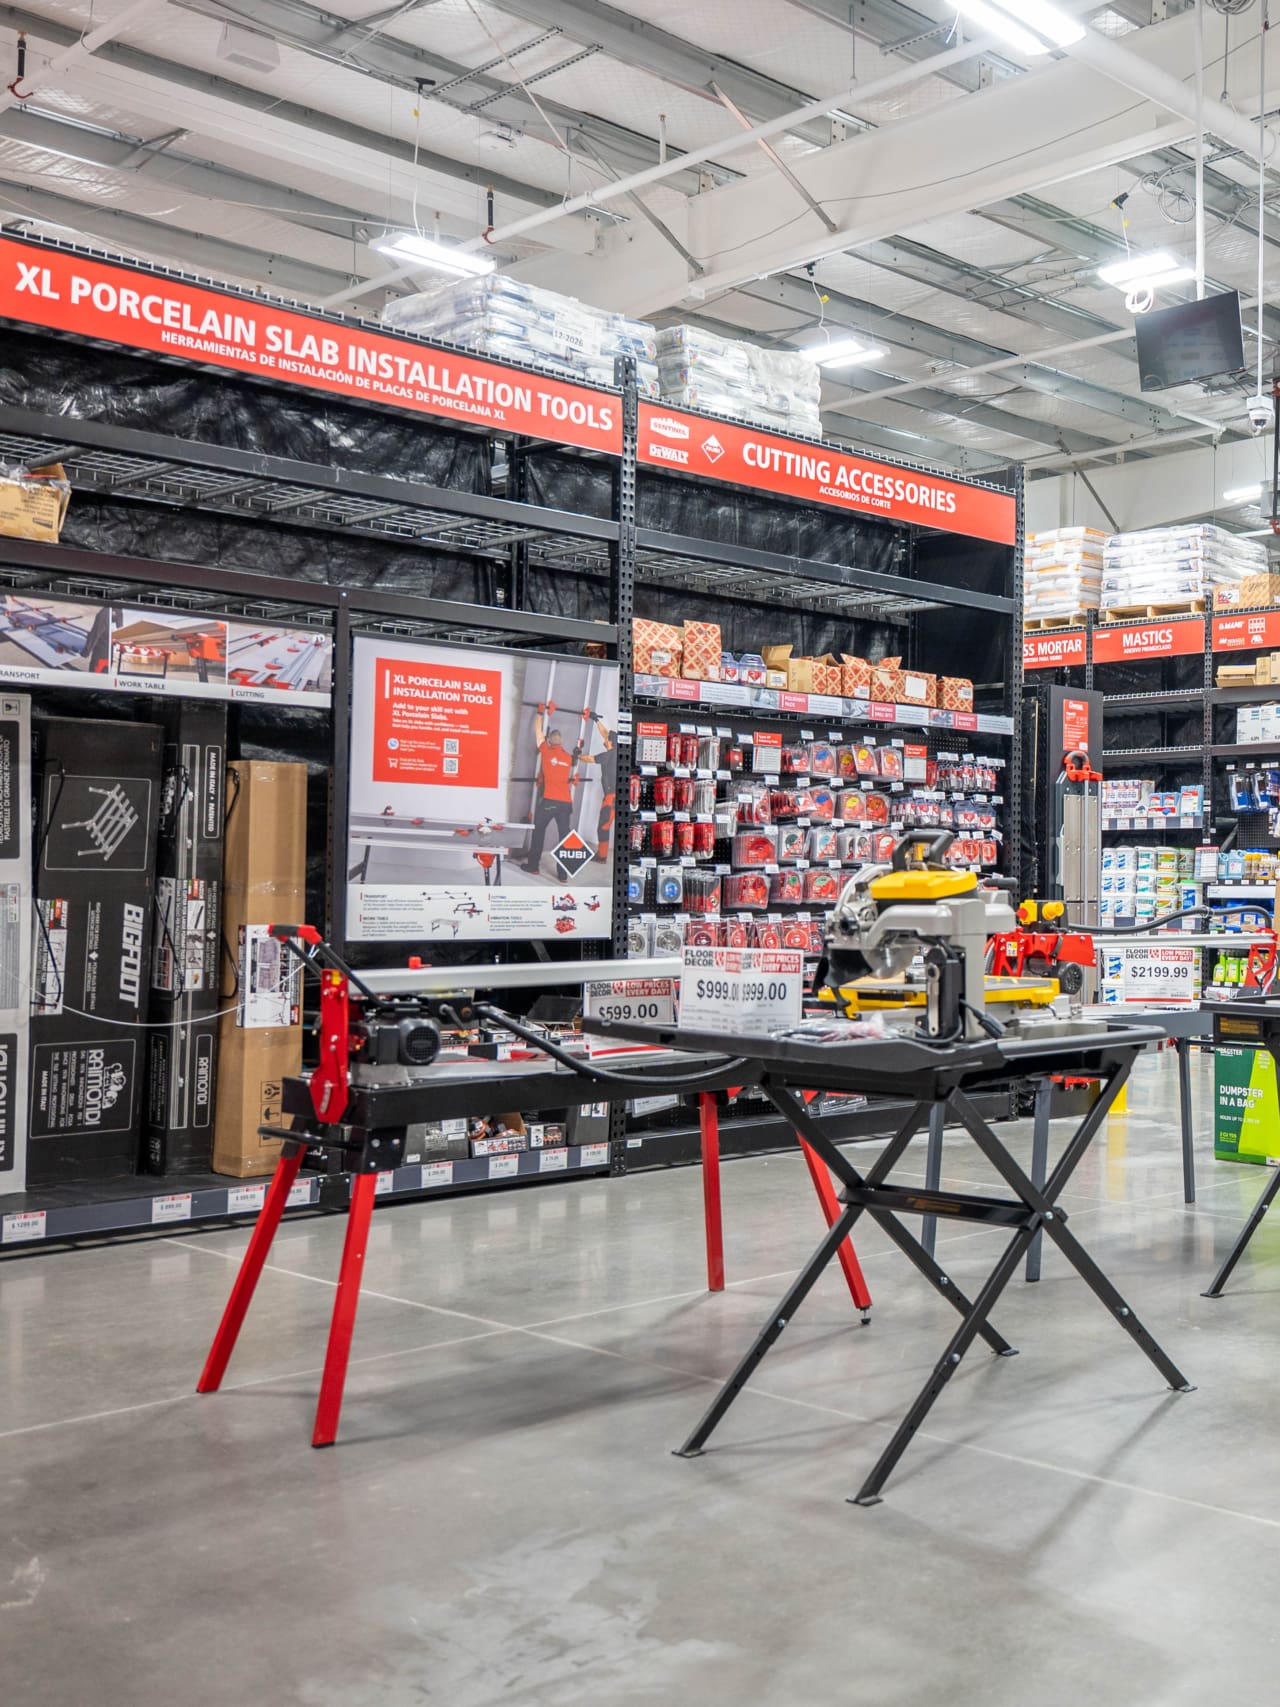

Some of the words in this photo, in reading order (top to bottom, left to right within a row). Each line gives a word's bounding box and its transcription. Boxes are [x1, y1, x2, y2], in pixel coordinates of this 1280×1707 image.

[14, 261, 60, 300] XL
[70, 276, 257, 348] PORCELAIN
[265, 325, 340, 366] SLAB
[347, 344, 532, 413] INSTALLATION
[536, 391, 614, 432] TOOLS
[161, 331, 257, 365] HERRAMIENTAS
[259, 355, 276, 369] DE
[278, 357, 354, 386] INSTALACIÓN
[355, 376, 371, 390] DE
[372, 379, 415, 400] PLACAS
[415, 389, 430, 403] DE
[431, 392, 492, 418] PORCELANA
[493, 408, 507, 421] XL
[742, 441, 831, 480] CUTTING
[834, 465, 956, 514] ACCESSORIES
[819, 485, 860, 504] ACCESORIOS
[861, 495, 870, 505] DE
[871, 497, 891, 510] CORTE
[1122, 628, 1173, 647] MASTICS
[1037, 639, 1083, 655] MORTAR
[119, 680, 142, 689] WORK
[144, 682, 166, 691] TABLE
[393, 674, 406, 684] XL
[408, 675, 461, 690] PORCELAIN
[463, 682, 487, 692] SLAB
[393, 687, 460, 702] INSTALLATION
[462, 694, 493, 705] TOOLS
[559, 849, 587, 861] RUBI
[119, 902, 145, 1009] BIGFOOT
[685, 950, 713, 959] FLOOR
[762, 954, 774, 962] LOW
[776, 955, 800, 963] PRICES
[685, 958, 713, 967] DECOR
[762, 963, 779, 972] EVERY
[781, 963, 800, 972] DAY!
[1131, 966, 1189, 978] $2199.99
[590, 982, 612, 990] FLOOR
[626, 981, 642, 989] LOW
[644, 980, 671, 988] PRICES
[626, 988, 649, 996] EVERY
[650, 987, 671, 996] DAY!
[599, 1003, 658, 1020] $599.00
[85, 1048, 106, 1126] RAIMONDI
[197, 1056, 209, 1105] RAIMONDI
[1219, 1084, 1264, 1098] DUMPSTER
[1219, 1096, 1229, 1106] IN
[1229, 1097, 1236, 1107] A
[1236, 1098, 1256, 1109] BAG
